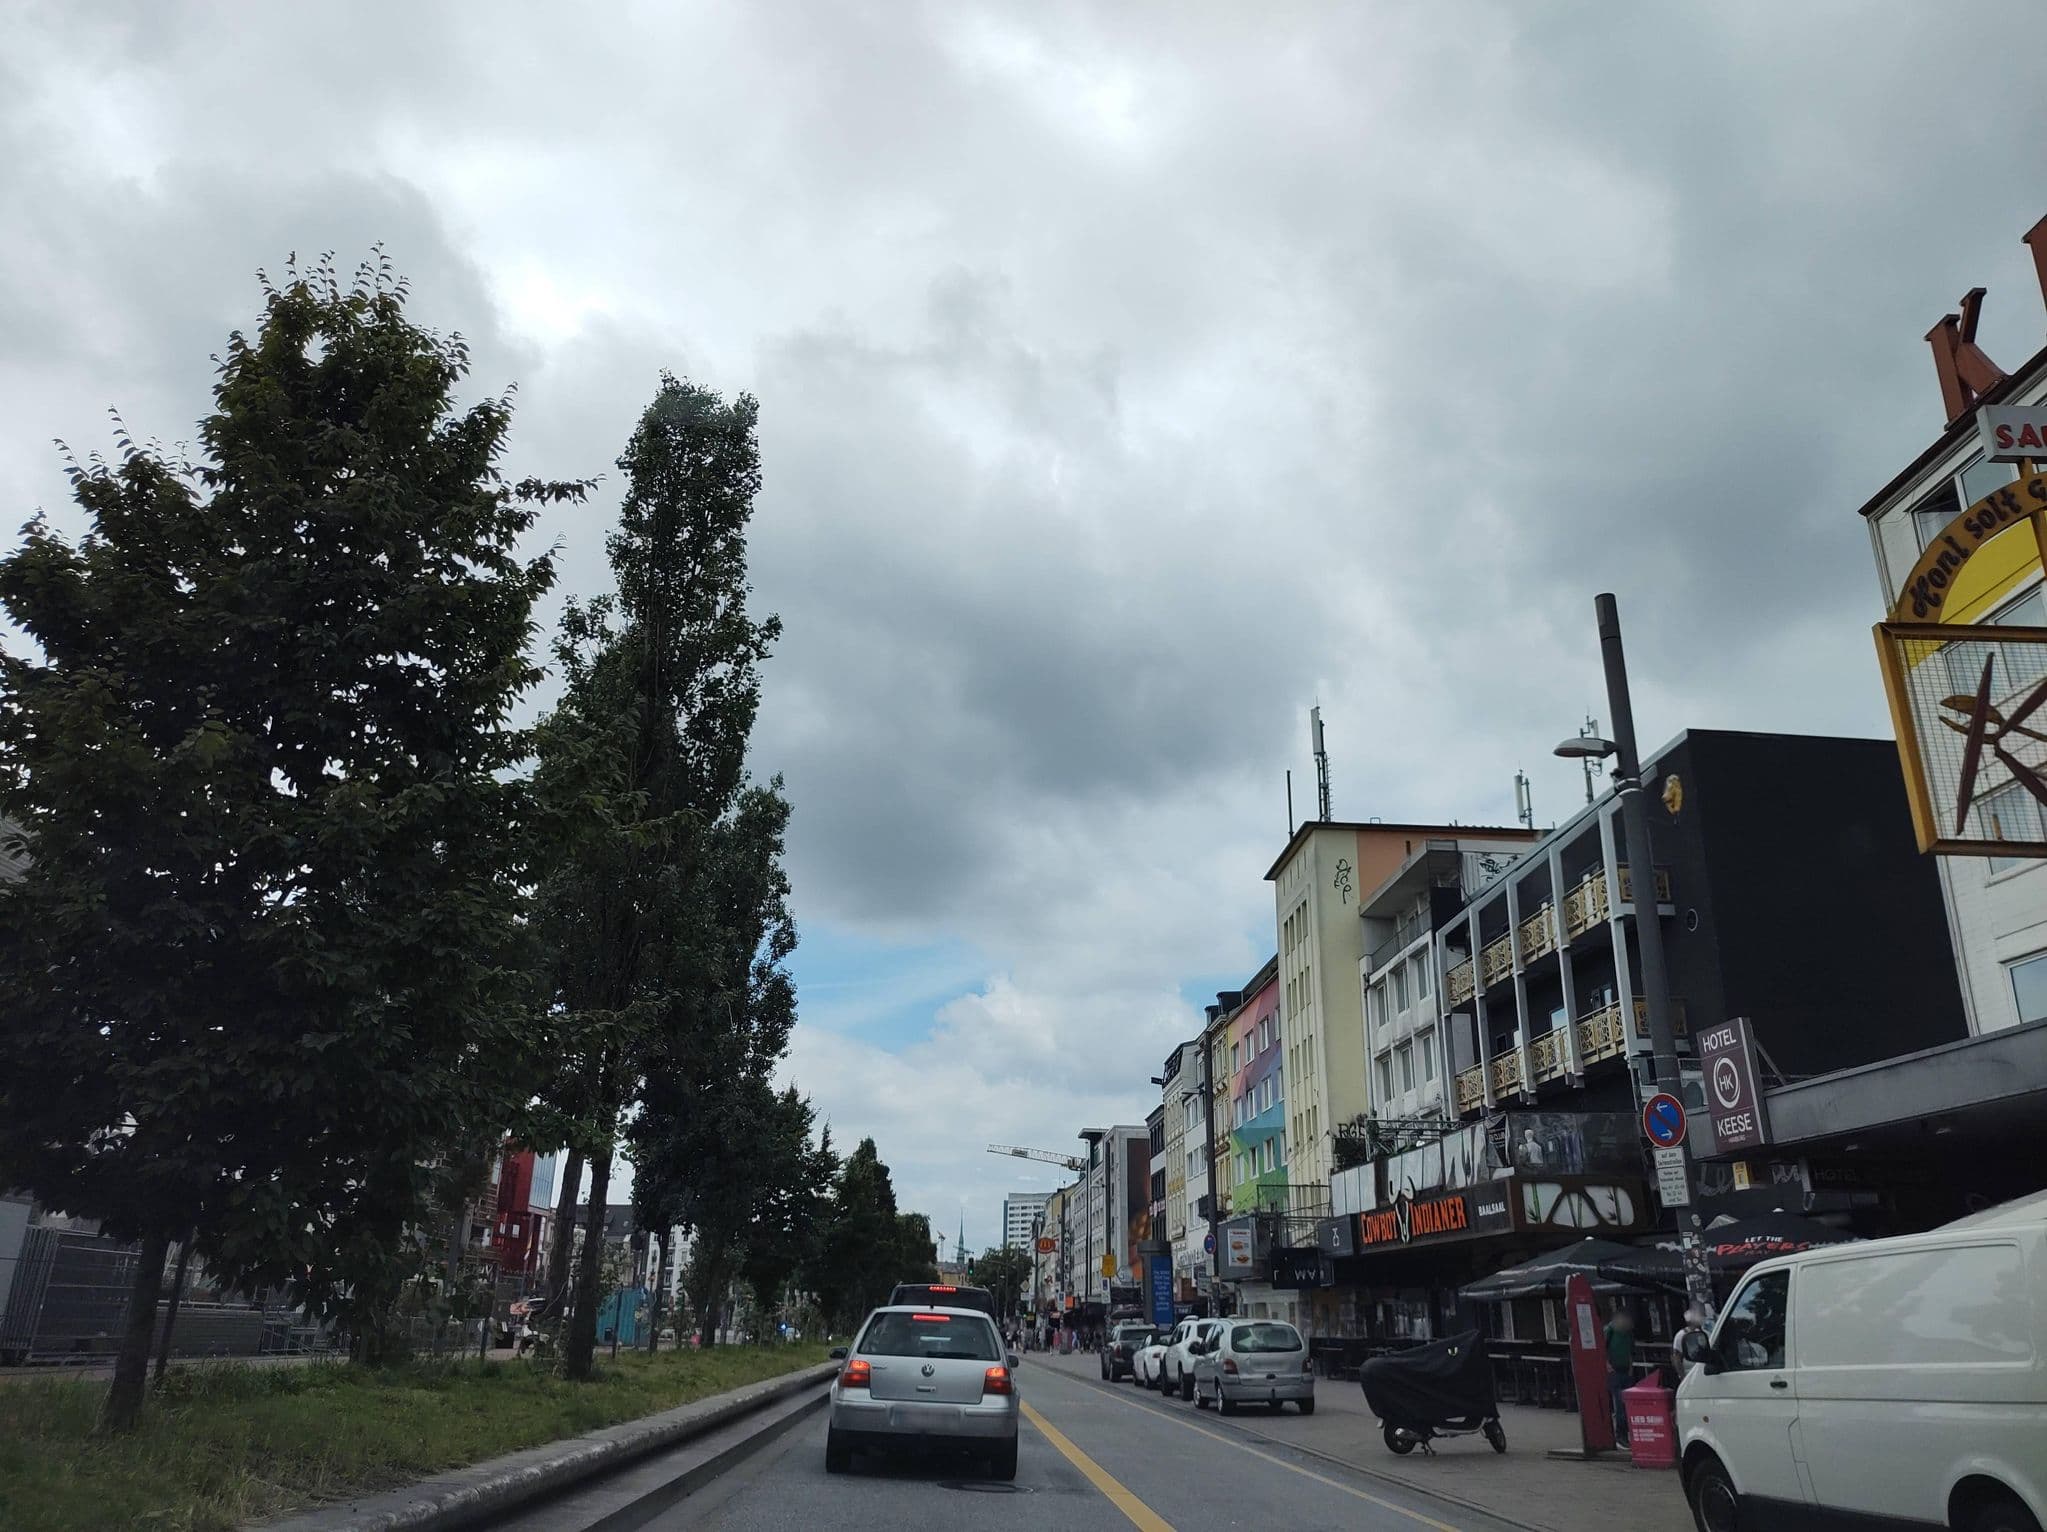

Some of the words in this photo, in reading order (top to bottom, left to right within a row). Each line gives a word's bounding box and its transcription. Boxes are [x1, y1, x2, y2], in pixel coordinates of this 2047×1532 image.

[1702, 1027, 1737, 1053] HOTEL
[1718, 1073, 1734, 1093] HK
[1716, 1112, 1753, 1137] KEESE
[1360, 1210, 1399, 1244] COWBOY
[1408, 1196, 1467, 1236] INDIANER
